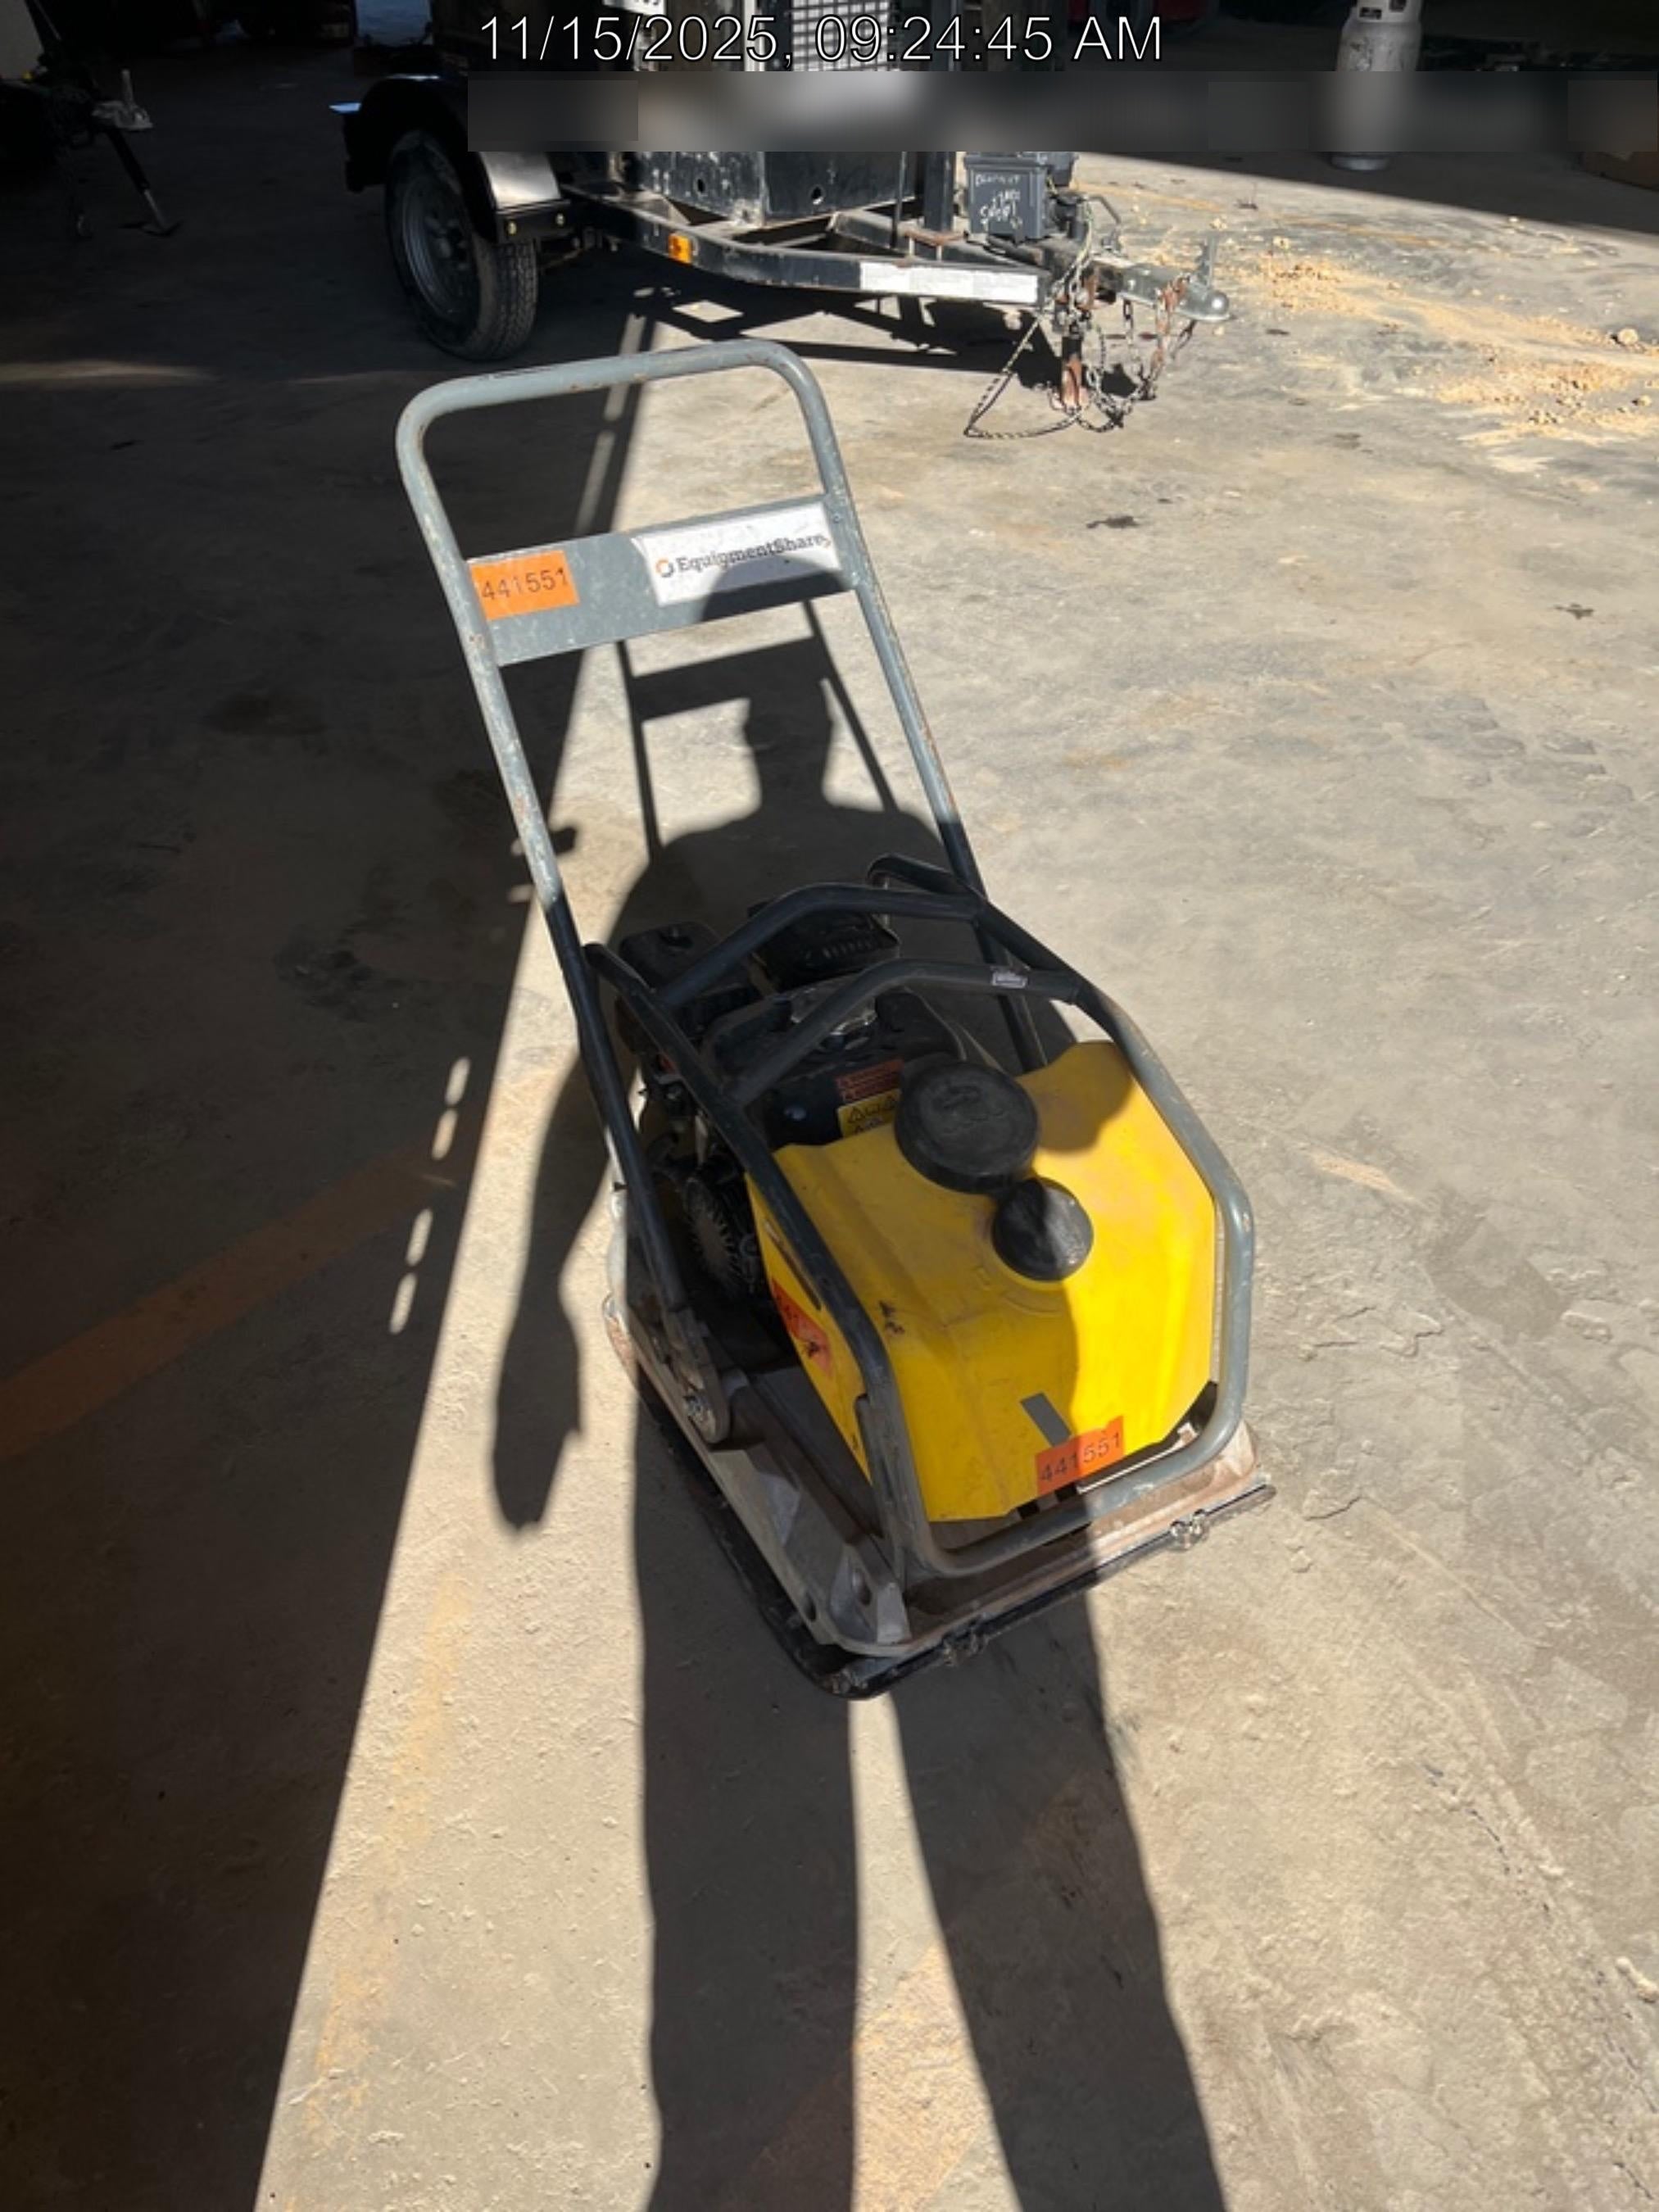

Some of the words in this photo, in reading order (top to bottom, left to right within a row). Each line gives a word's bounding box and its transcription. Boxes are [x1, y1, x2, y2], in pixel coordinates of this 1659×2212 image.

[676, 533, 827, 572] EquipmentShare
[481, 567, 569, 600] 441551
[1040, 1431, 1120, 1481] 441551
